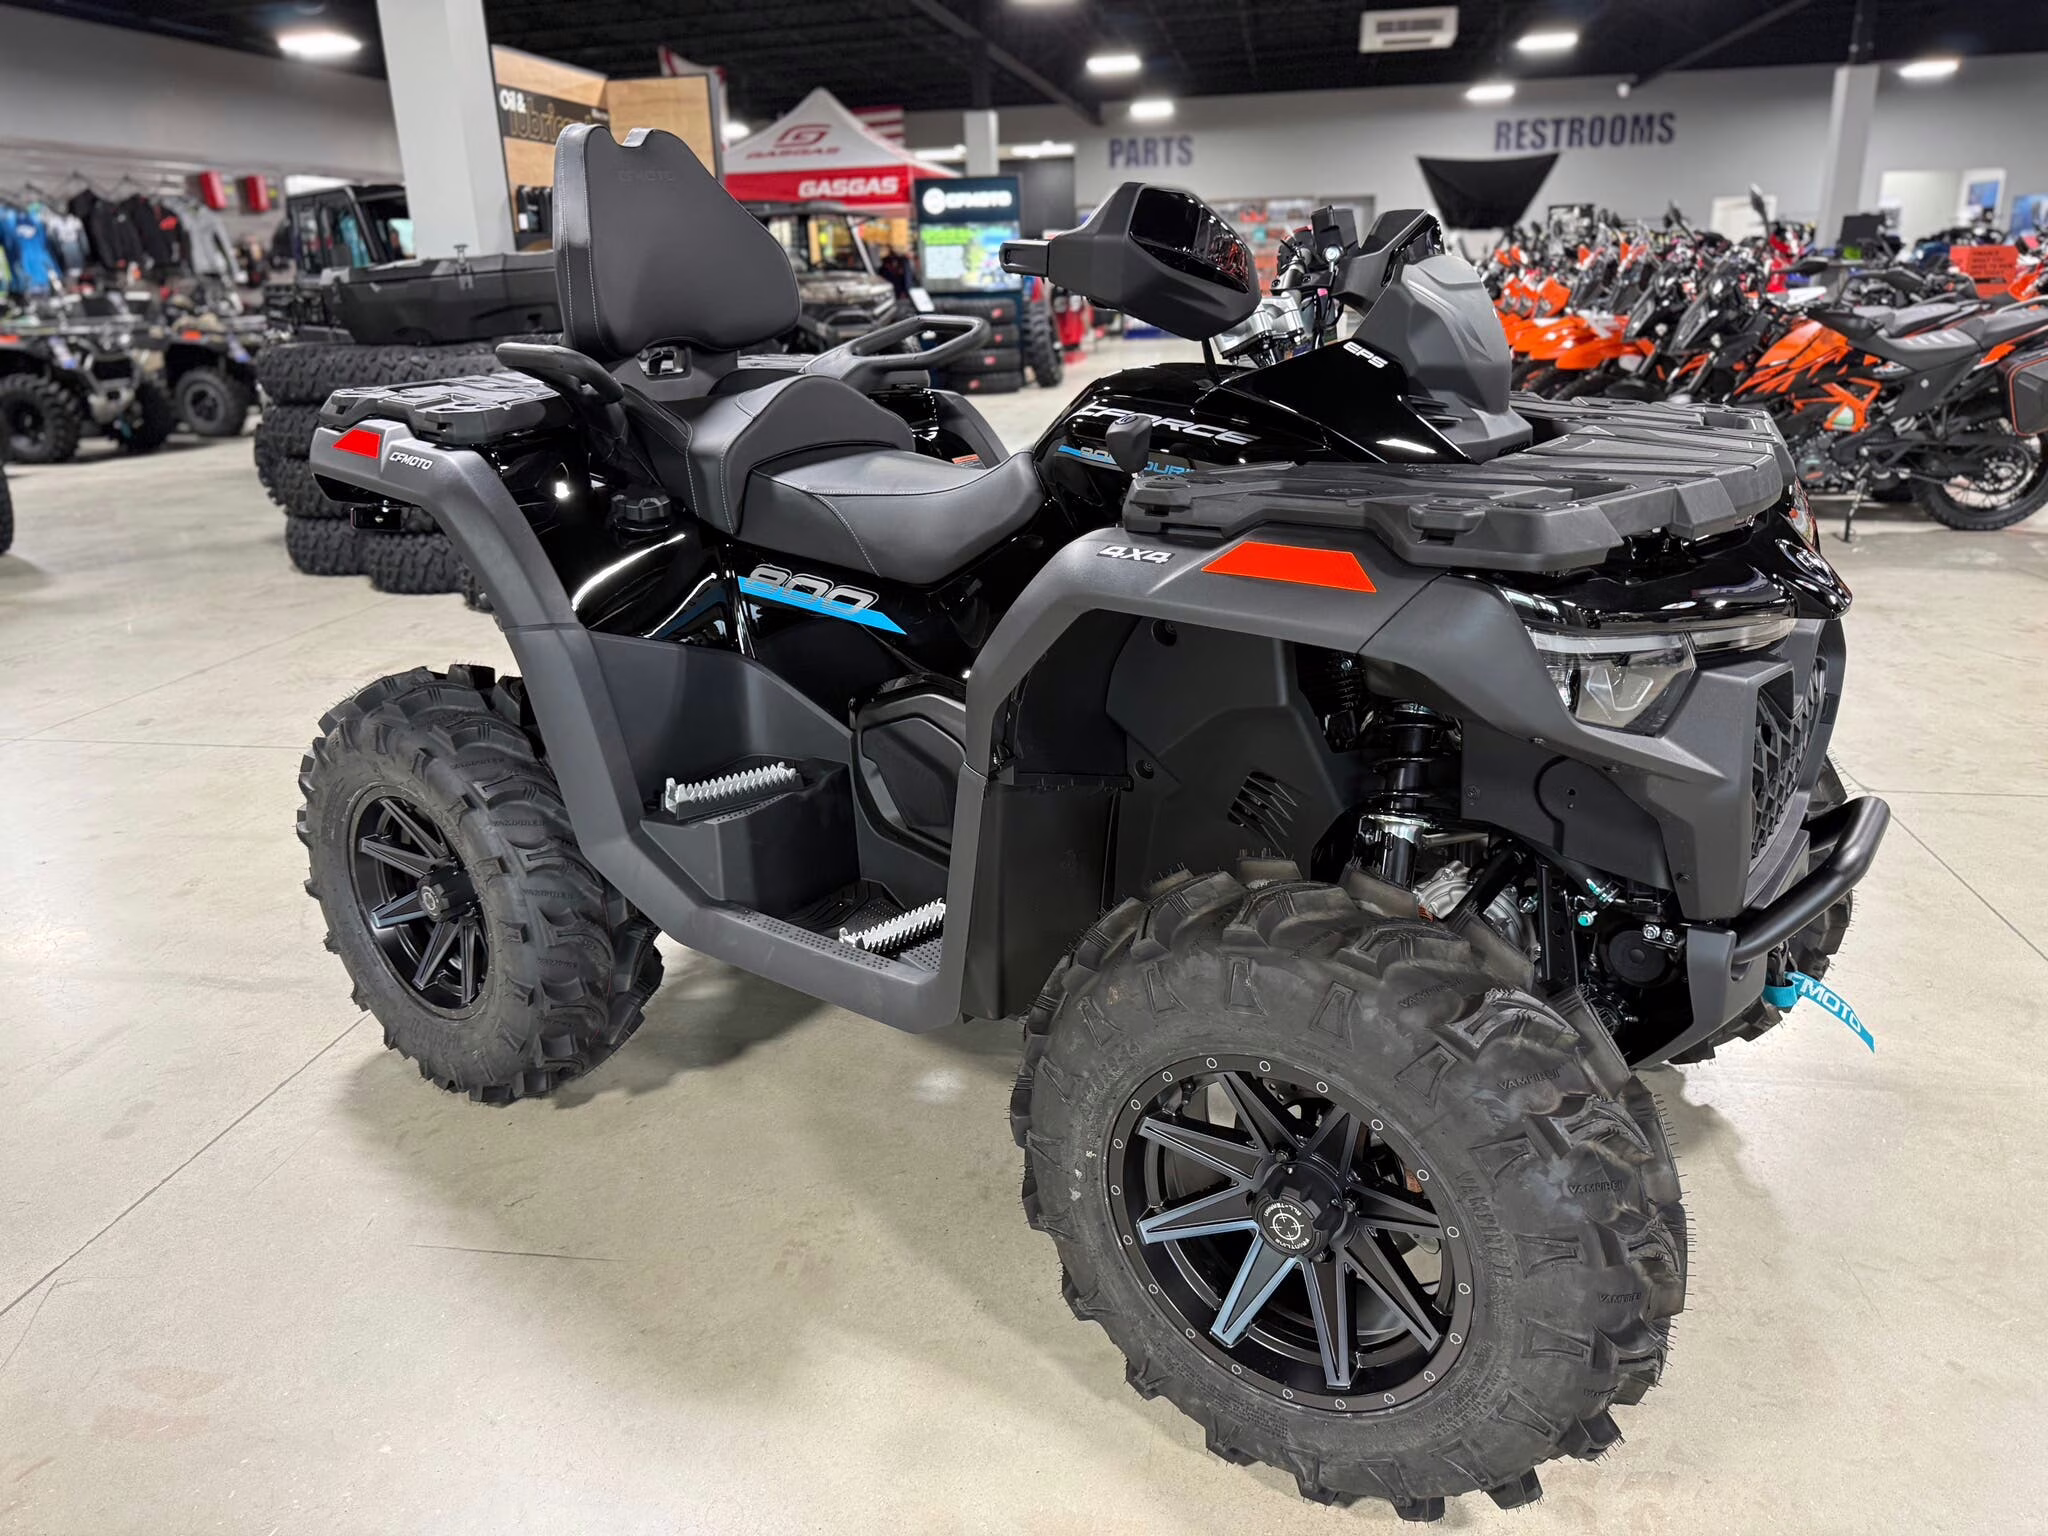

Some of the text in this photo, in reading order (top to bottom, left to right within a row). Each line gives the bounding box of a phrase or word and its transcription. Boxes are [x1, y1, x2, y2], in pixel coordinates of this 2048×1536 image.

[1495, 112, 1676, 151] RESTROOMS
[1108, 136, 1194, 169] PARTS
[798, 176, 899, 198] GASGAS
[1343, 341, 1389, 369] EPS
[389, 451, 433, 470] CFMOTO
